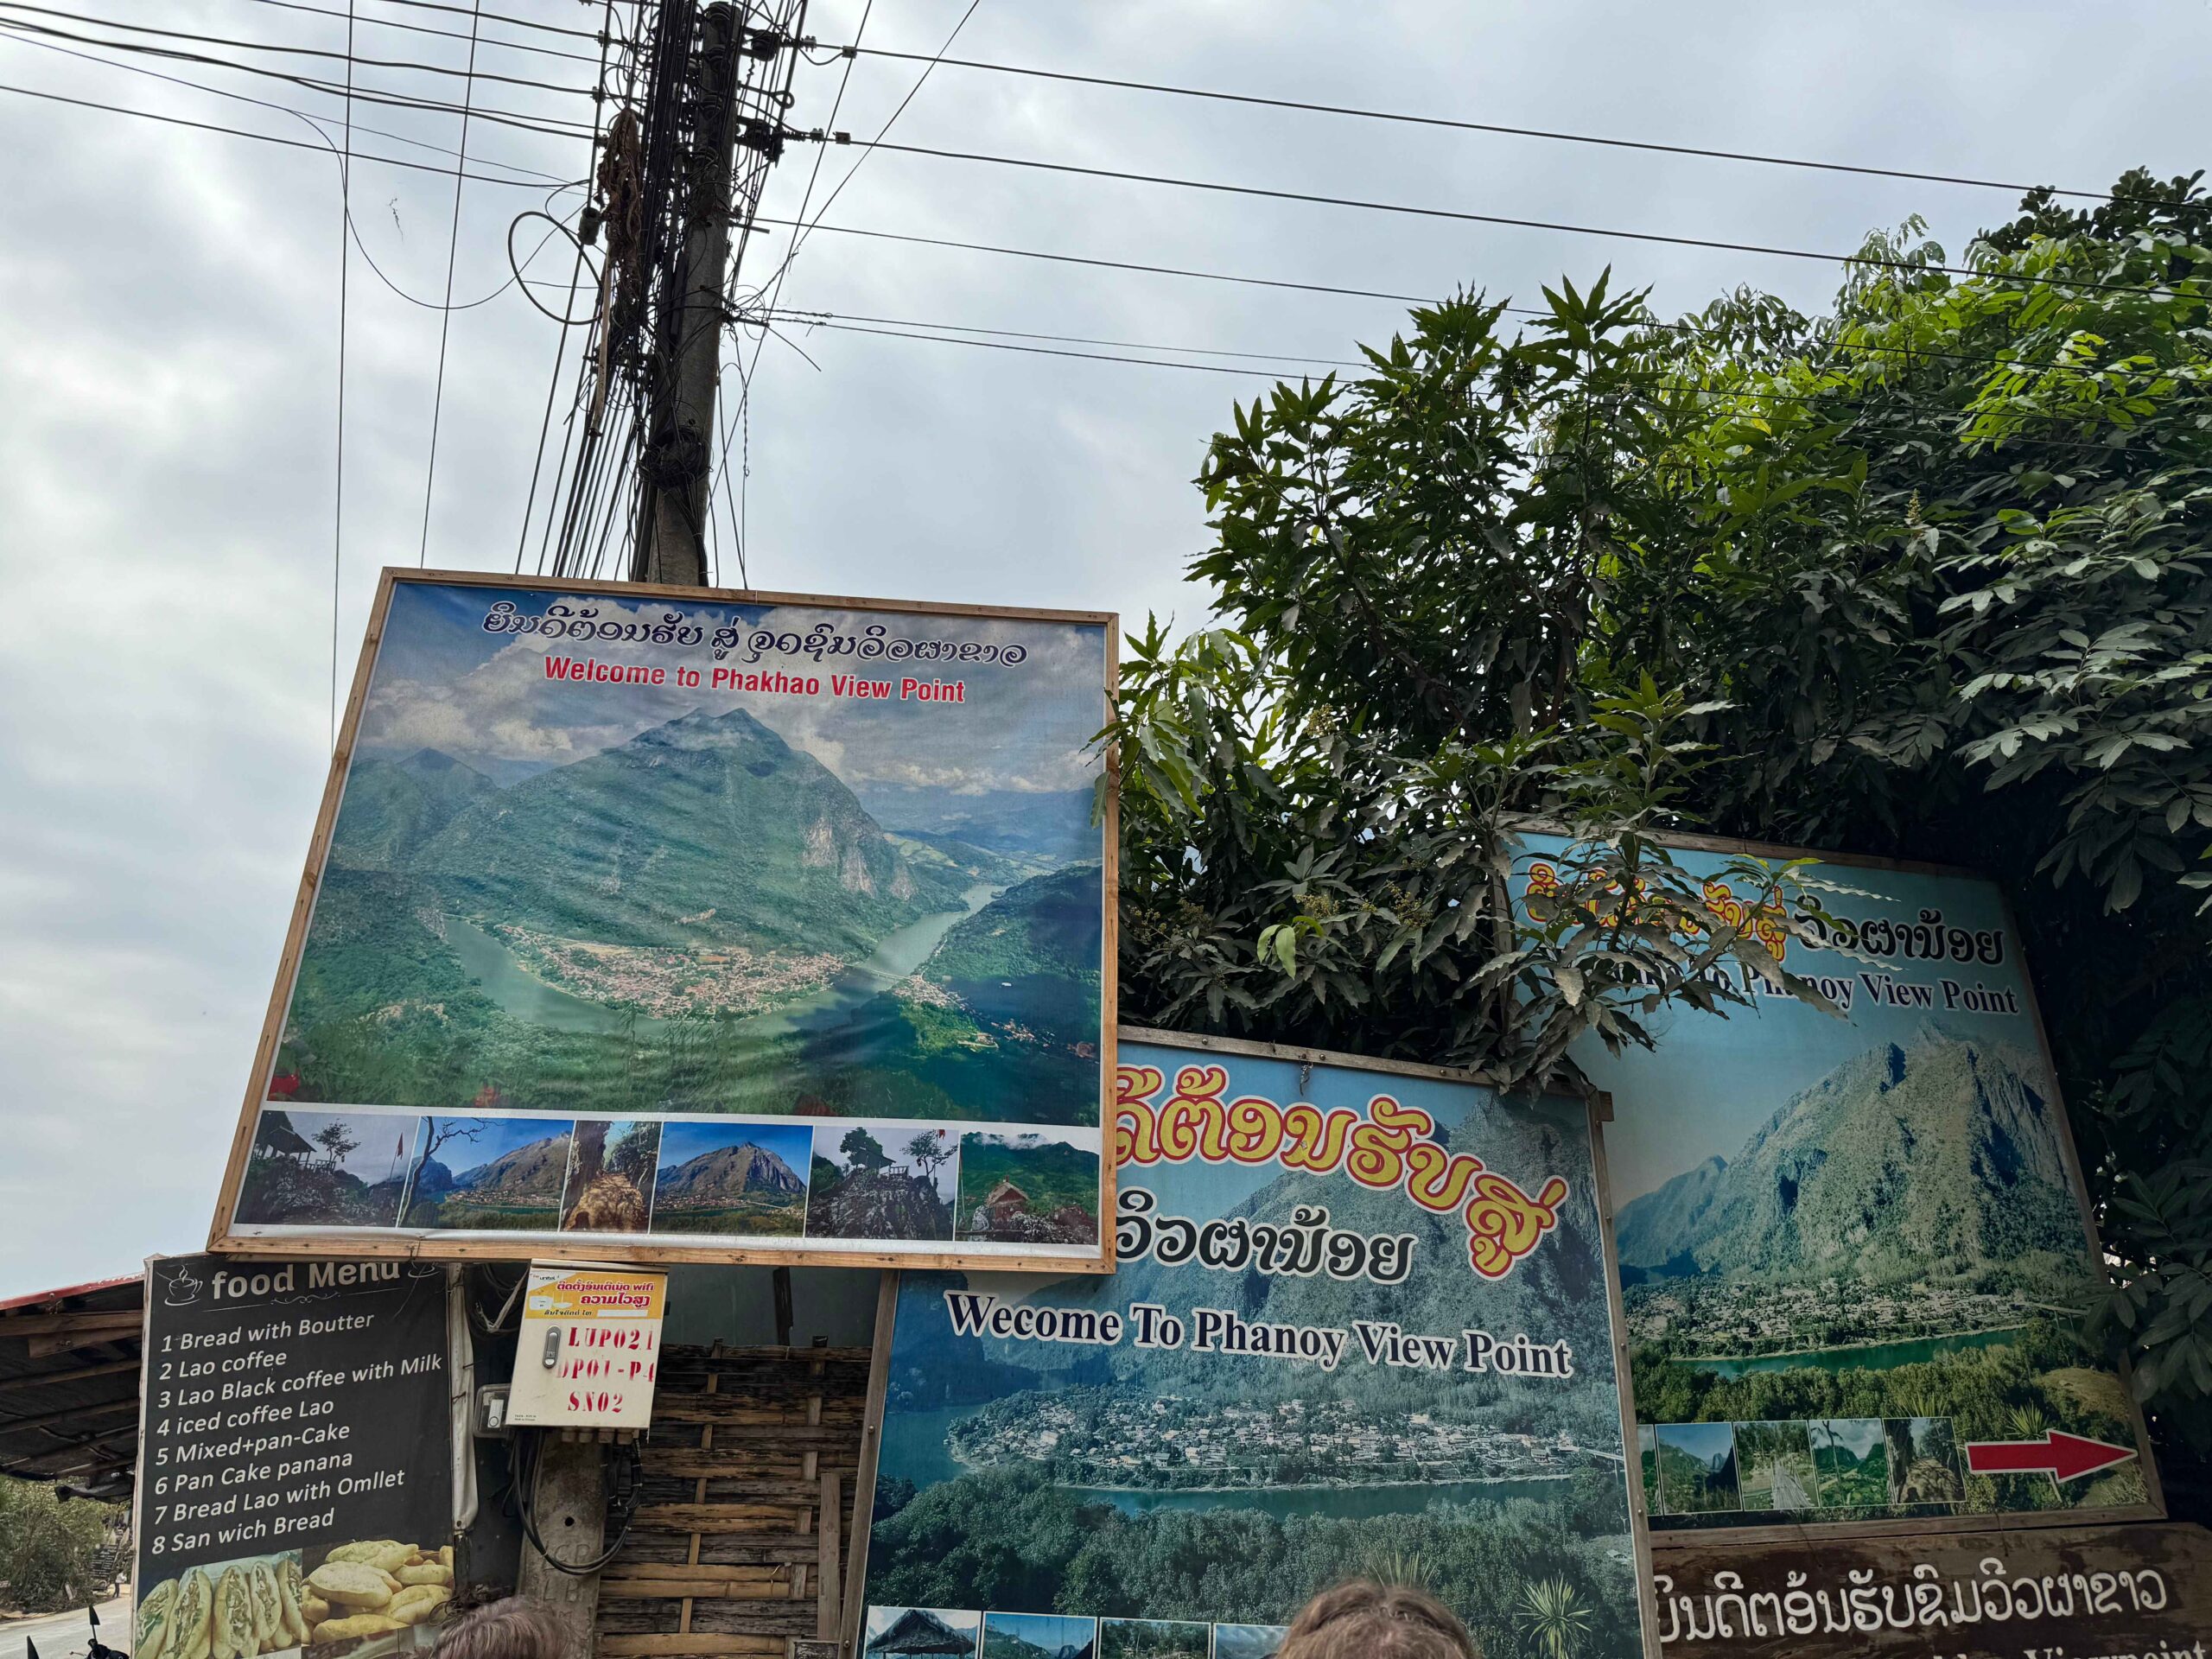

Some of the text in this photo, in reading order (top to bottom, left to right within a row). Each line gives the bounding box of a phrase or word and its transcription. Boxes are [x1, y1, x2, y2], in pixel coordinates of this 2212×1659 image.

[545, 656, 965, 702] Welcome to Phakhao View Point
[1859, 973, 1933, 1007] View
[1940, 980, 2019, 1014] Point
[212, 1262, 401, 1300] food Menu
[632, 1282, 655, 1291] wifi
[161, 1314, 374, 1353] 1 Bread with Boutter
[568, 1325, 653, 1351] LUP021
[947, 1293, 1572, 1376] Wecome To Phanoy View Point
[157, 1353, 442, 1408] 3 Lao Black coffee with Milk
[158, 1350, 287, 1381] 2 Lao coffee
[156, 1401, 334, 1437] 4 iced coffee Lao
[568, 1391, 624, 1414] SN02
[155, 1422, 350, 1466] 5 Mixed+pan-Cake
[155, 1452, 353, 1495] 6 Pan Cake panana
[155, 1469, 405, 1525] 7 Bread Lao with Omllet
[151, 1507, 335, 1555] 8 San wich Bread
